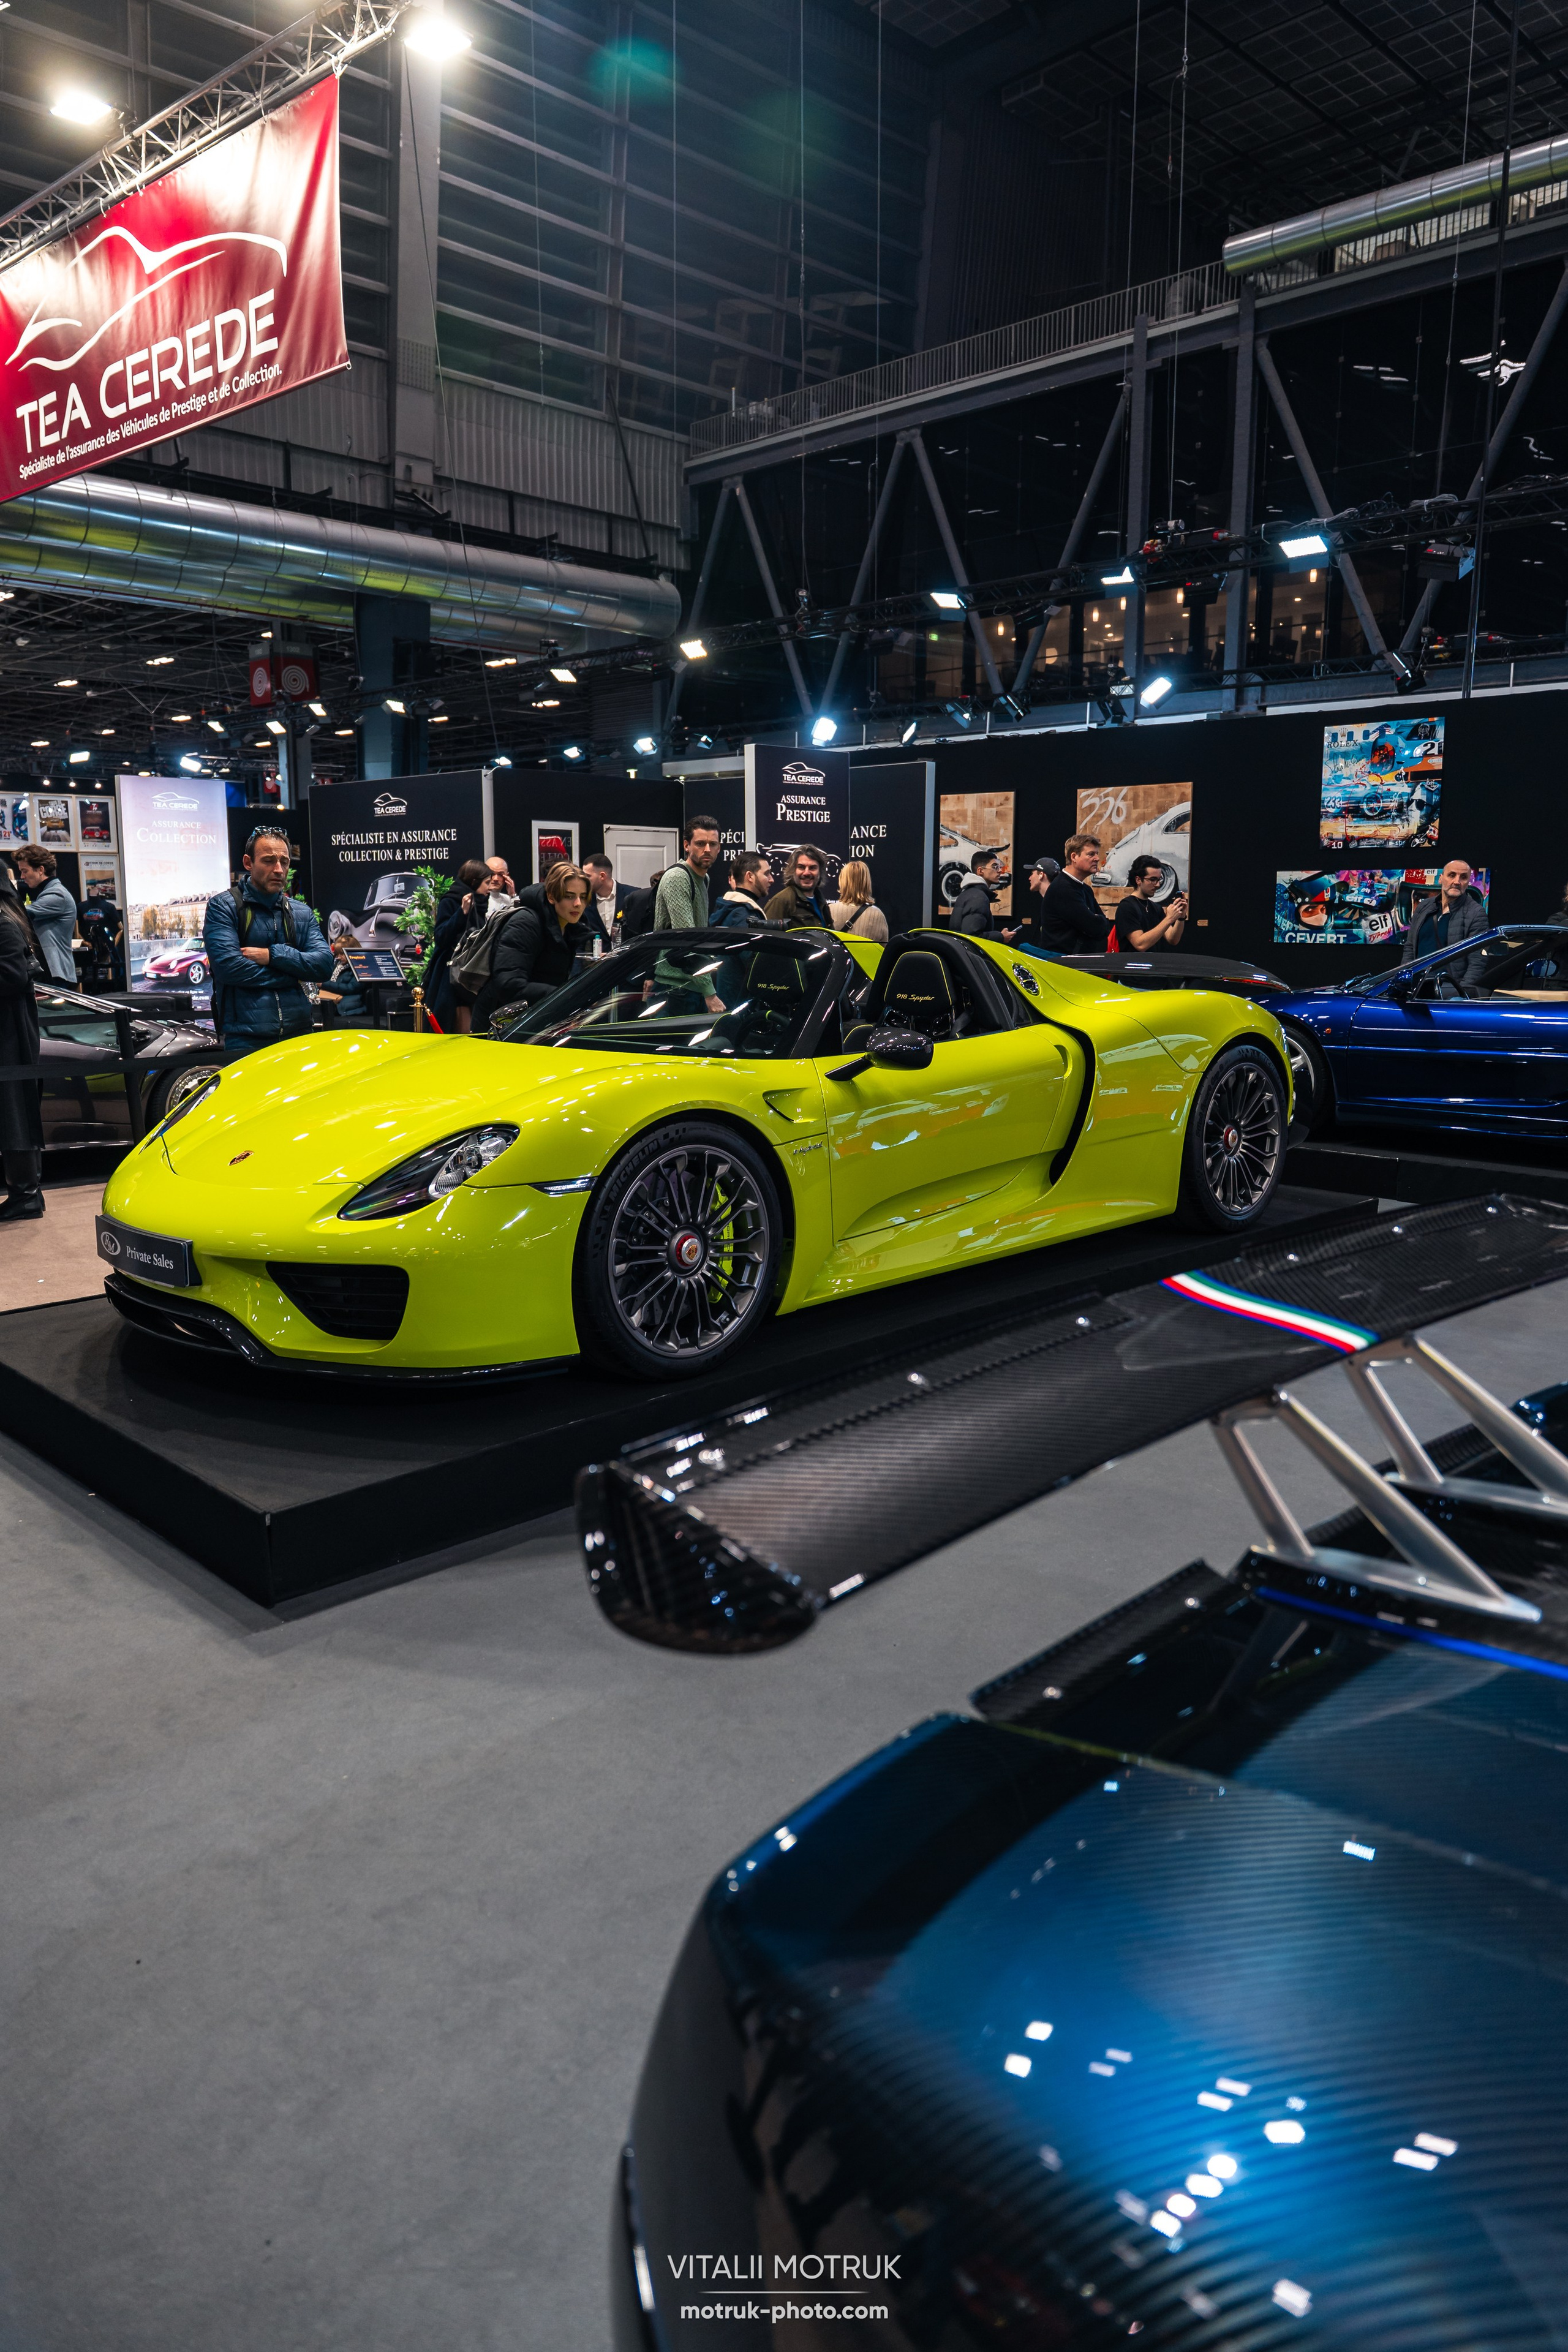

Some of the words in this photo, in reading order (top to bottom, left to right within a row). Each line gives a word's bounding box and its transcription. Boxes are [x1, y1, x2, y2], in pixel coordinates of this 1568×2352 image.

[16, 382, 91, 453] TEA
[99, 288, 279, 419] CEREDE
[19, 452, 56, 480] Spécialiste
[56, 449, 66, 464] de
[66, 437, 105, 462] l'assurance
[107, 428, 120, 447] des
[120, 417, 159, 438] Véhicules
[159, 409, 170, 424] de
[172, 393, 206, 420] Prestige
[208, 390, 218, 405] et
[219, 382, 231, 399] de
[232, 363, 282, 393] Collection.
[1327, 739, 1359, 748] ROLEX
[781, 795, 826, 805] ASSURANCE
[1079, 786, 1128, 831] 356
[1325, 797, 1343, 810] 233
[776, 803, 831, 823] PRESTIGE
[331, 831, 385, 845] SPÉCIALISTE
[387, 832, 398, 843] EN
[401, 829, 457, 843] ASSURANCE
[339, 849, 393, 862] COLLECTION
[395, 849, 402, 861] &
[404, 848, 449, 861] PRESTIGE
[849, 845, 875, 858] ION
[1369, 914, 1388, 932] elf
[1285, 932, 1347, 943] CEVERT
[609, 1139, 660, 1201] MICHELIN
[126, 1246, 151, 1264] Private
[153, 1253, 173, 1270] Sales
